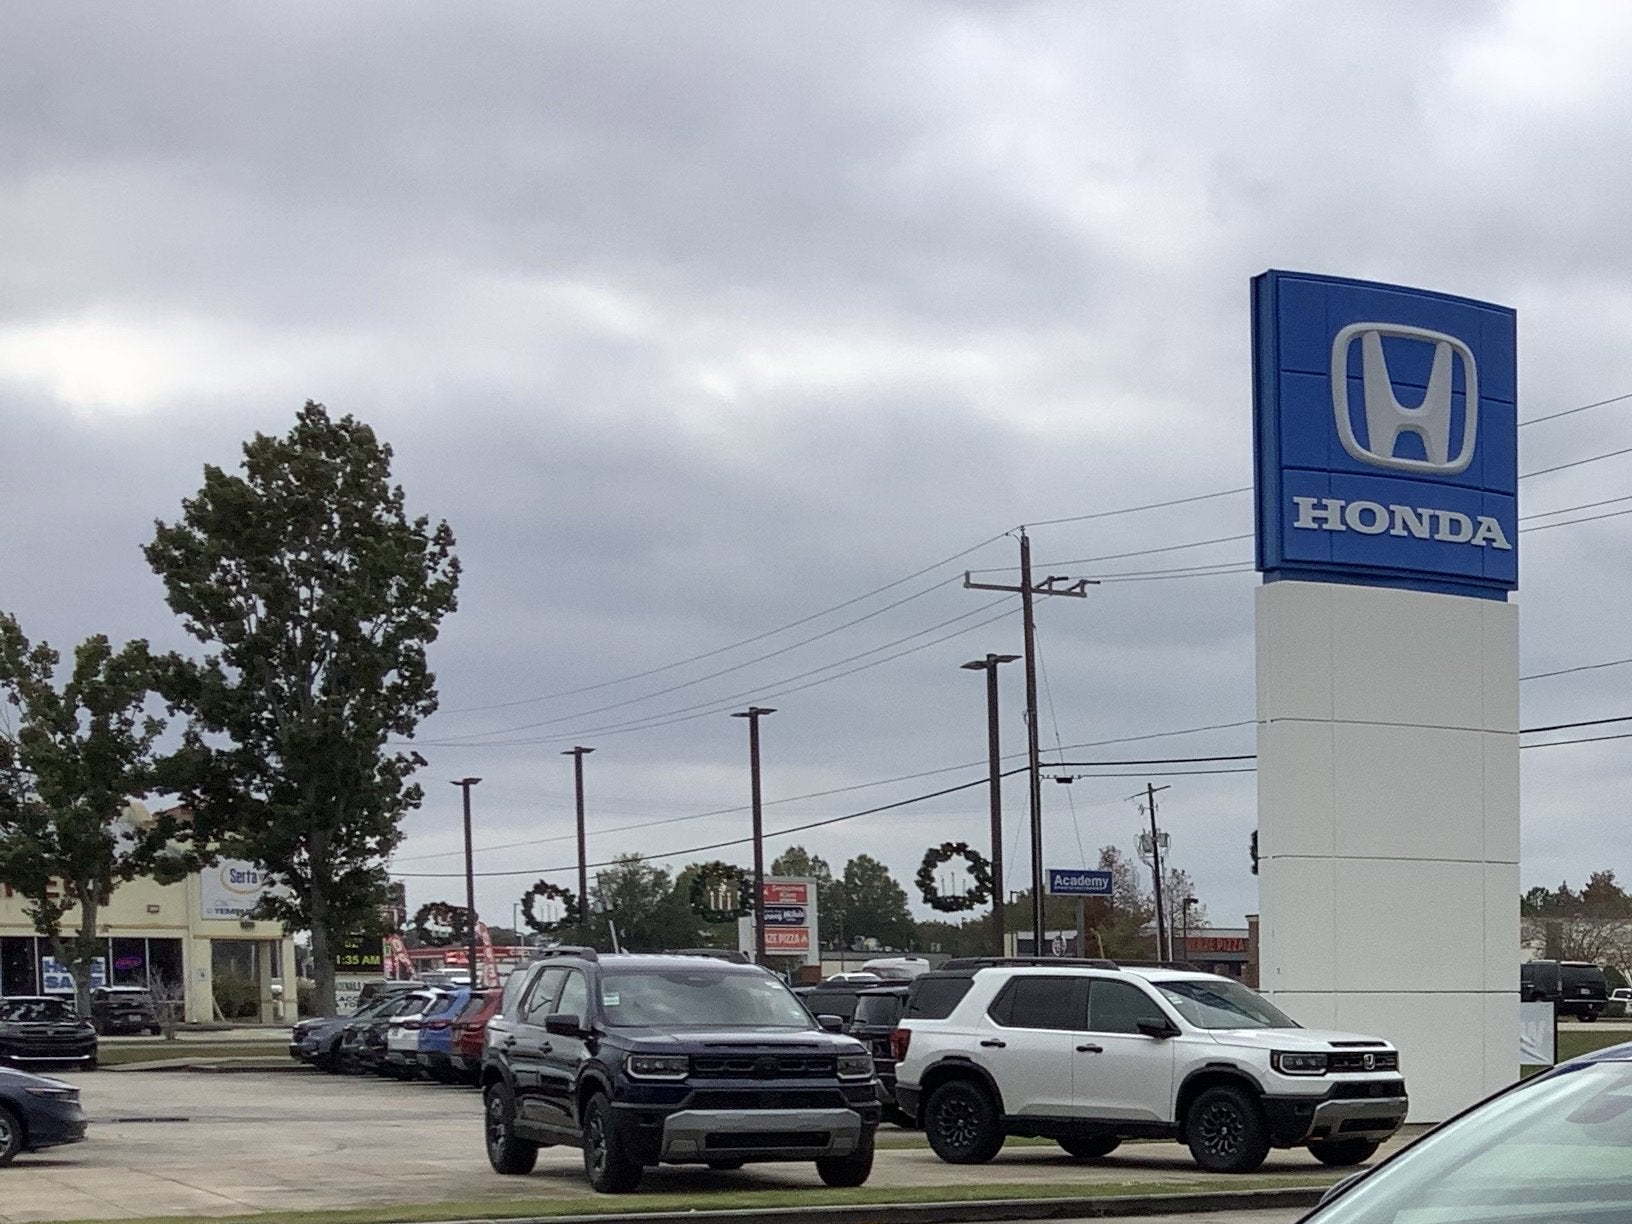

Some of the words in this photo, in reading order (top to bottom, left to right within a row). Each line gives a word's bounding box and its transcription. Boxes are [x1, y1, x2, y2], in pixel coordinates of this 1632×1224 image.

[1293, 496, 1512, 550] HONDA
[229, 868, 258, 885] Serta
[1054, 874, 1109, 889] Academy
[361, 955, 381, 966] AM
